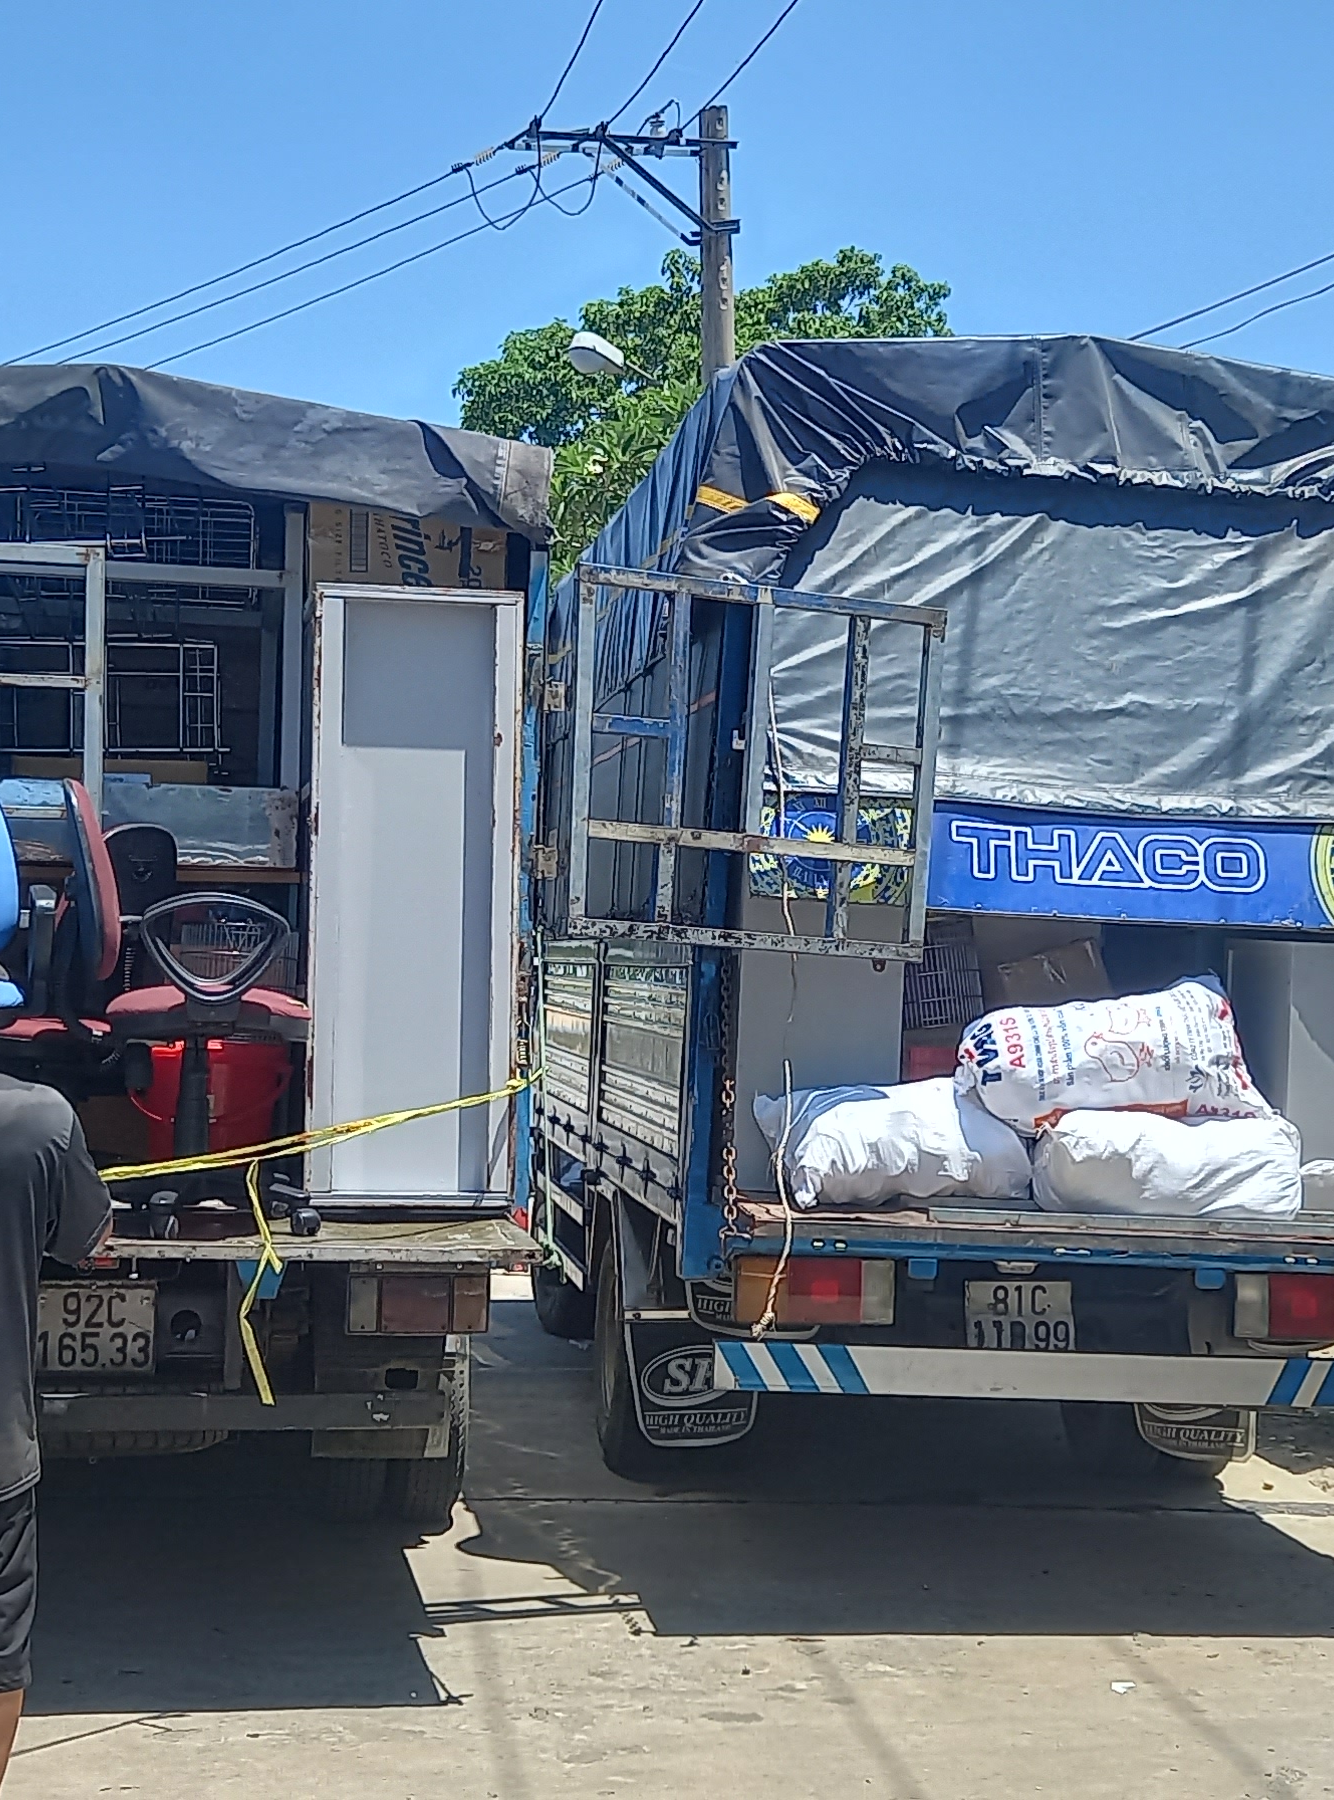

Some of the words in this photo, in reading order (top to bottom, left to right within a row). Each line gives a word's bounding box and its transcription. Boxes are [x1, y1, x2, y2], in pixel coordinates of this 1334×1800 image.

[389, 515, 432, 587] rince
[950, 820, 1266, 893] THACO
[61, 1291, 127, 1329] 92C
[992, 1284, 1048, 1317] 81C
[37, 1330, 151, 1368] 165.33
[645, 1414, 678, 1426] HIGH
[683, 1411, 747, 1427] QUALITY
[1179, 1428, 1246, 1443] QUALITY
